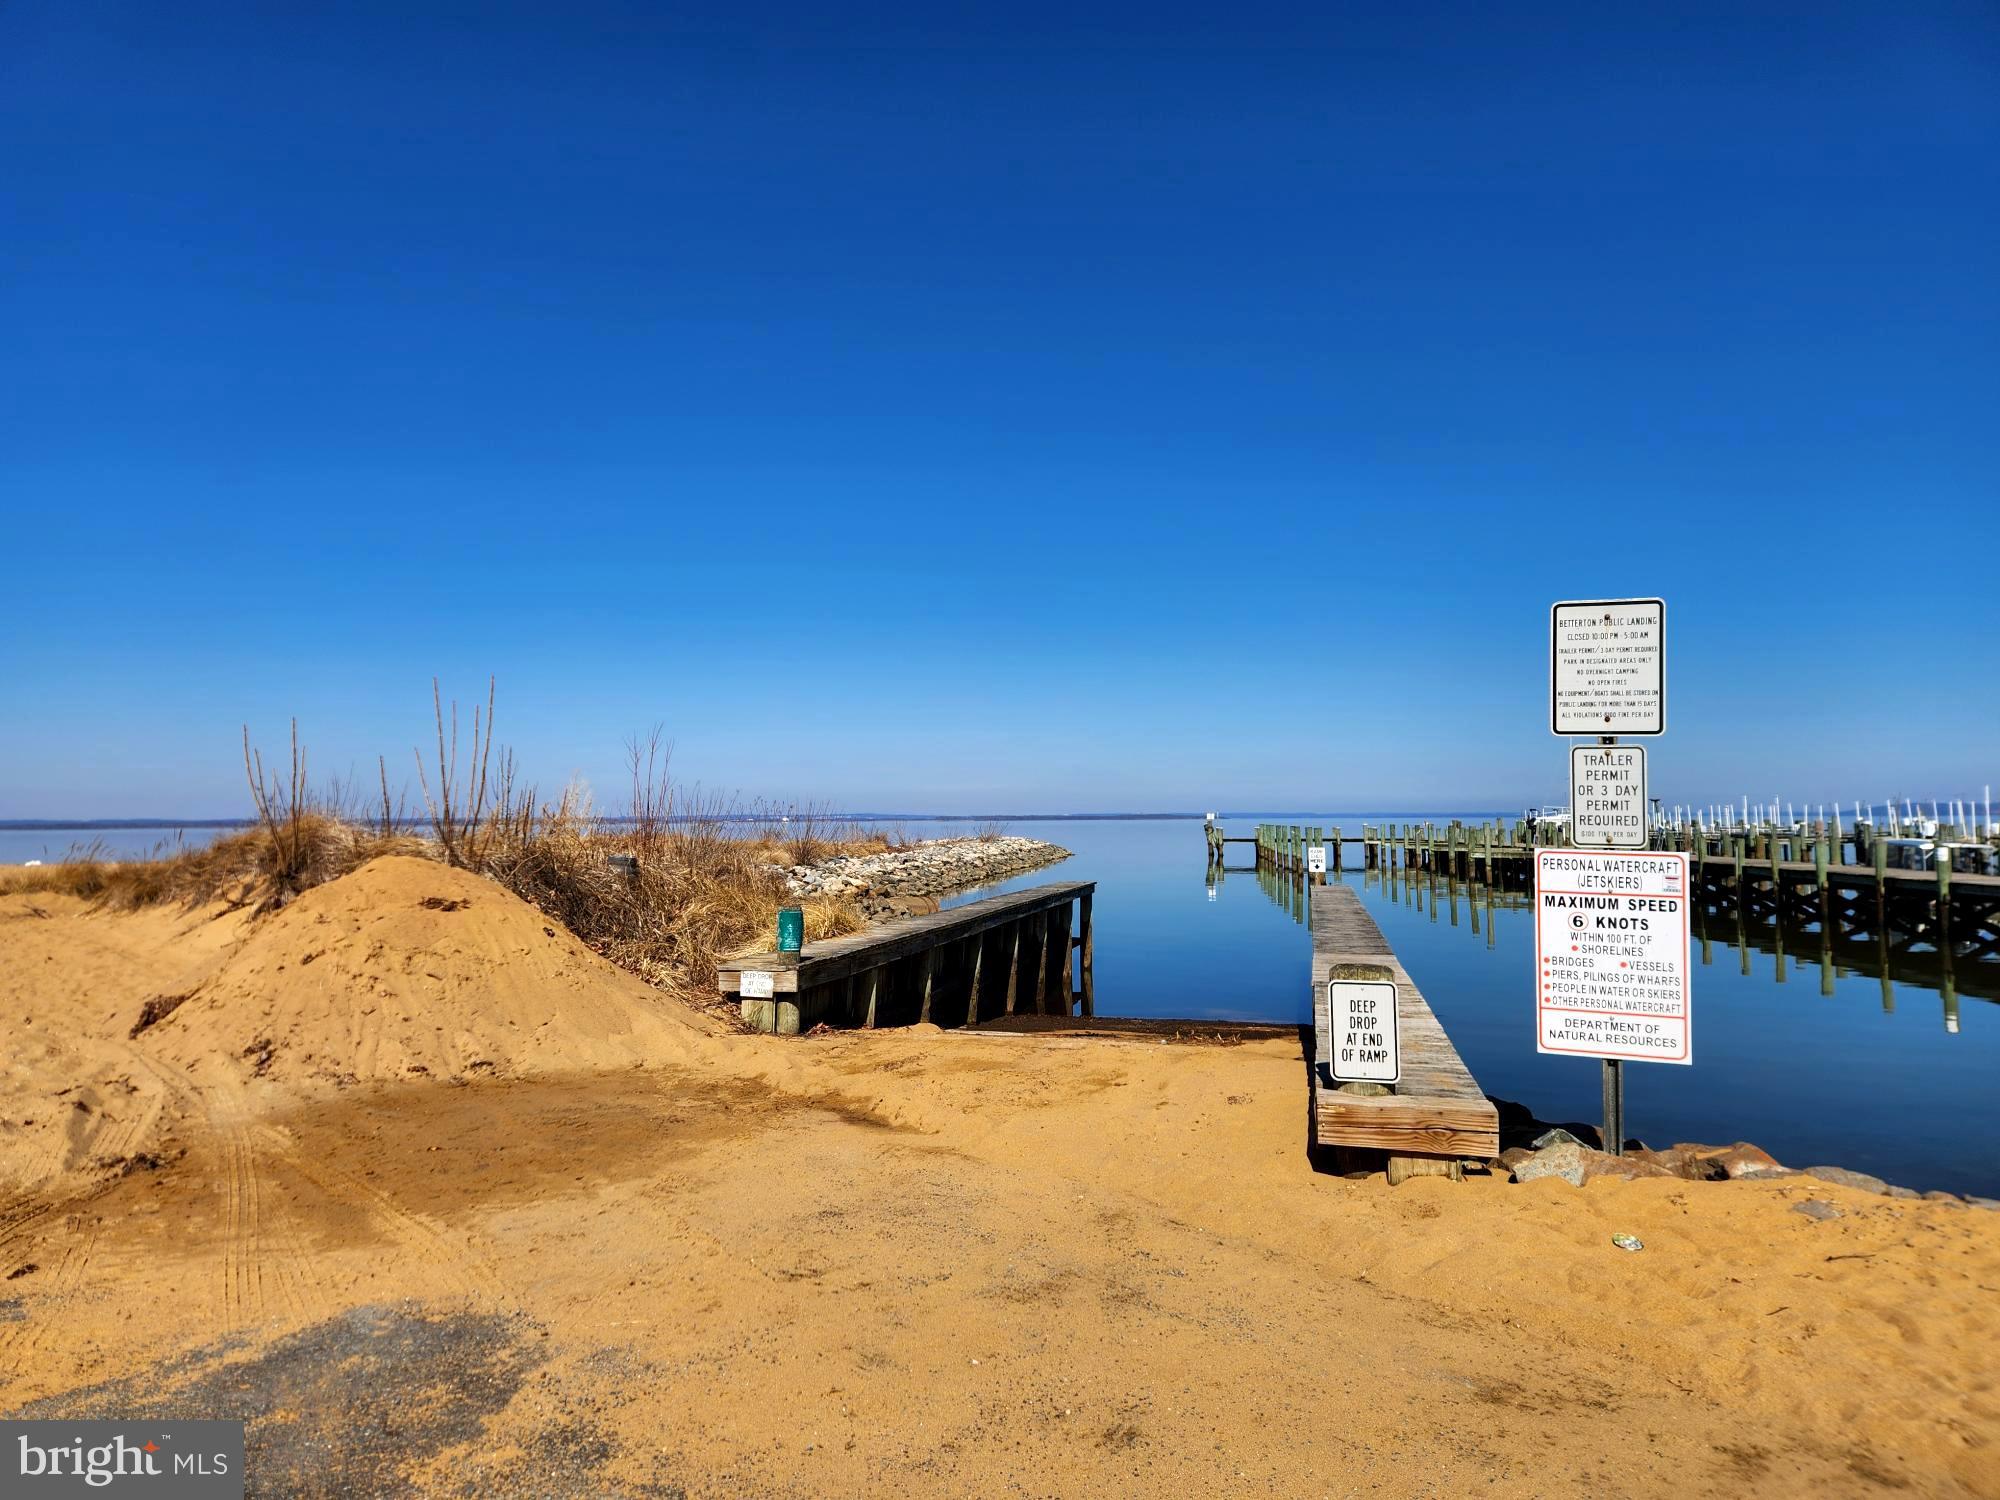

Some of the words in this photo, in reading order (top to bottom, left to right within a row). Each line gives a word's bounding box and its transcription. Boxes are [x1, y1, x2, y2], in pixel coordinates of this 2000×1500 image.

[1559, 619, 1596, 627] BETTERTON
[1599, 617, 1624, 626] PUBLIC
[1626, 617, 1657, 626] LANDING
[1567, 632, 1590, 640] CLOSED
[1592, 632, 1608, 640] 10:00
[1584, 754, 1632, 766] TRAILER
[1586, 770, 1630, 780] PERMIT
[1578, 784, 1594, 796] OR
[1600, 785, 1608, 796] 3
[1616, 785, 1638, 796] DAY
[1586, 800, 1630, 811] PERMIT
[1580, 814, 1638, 826] REQUIRED
[1543, 858, 1600, 872] PERSONAL
[1604, 860, 1679, 874] WATERCRAFT
[1577, 874, 1643, 891] (JETSKIERS)
[1544, 895, 1619, 910] MAXIMUM
[1628, 898, 1678, 912] SPEED
[1572, 916, 1584, 928] 6
[1596, 916, 1649, 930] KNOTS
[1570, 932, 1604, 943] WITHIN
[1607, 934, 1622, 944] 100
[1624, 935, 1637, 945] FT.
[1639, 936, 1652, 945] OF
[1582, 944, 1644, 957] SHORELINES
[1552, 956, 1594, 968] BRIDGES
[1630, 960, 1674, 972] VESSELS
[1552, 970, 1582, 981] PIERS,
[1584, 972, 1620, 983] PILINGS
[1622, 974, 1635, 984] OF
[1638, 975, 1680, 986] WHARFS
[1552, 982, 1587, 994] PEOPLE
[1588, 985, 1597, 994] IN
[1599, 986, 1630, 997] WATER
[1632, 988, 1646, 998] OR
[1648, 989, 1680, 1000] SKIERS
[1350, 1000, 1376, 1013] DEEP
[1552, 996, 1578, 1007] OTHER
[1580, 998, 1624, 1010] PERSONAL
[1626, 1000, 1680, 1014] WATERCRAFT
[1350, 1016, 1378, 1030] DROP
[1564, 1018, 1641, 1034] DEPARTMENT
[1644, 1024, 1660, 1034] OF
[1346, 1032, 1357, 1046] AT
[1362, 1033, 1382, 1046] END
[1550, 1030, 1602, 1043] NATURAL
[1606, 1034, 1677, 1048] RESOURCES
[1342, 1048, 1354, 1062] OF
[1360, 1050, 1388, 1063] RAMP
